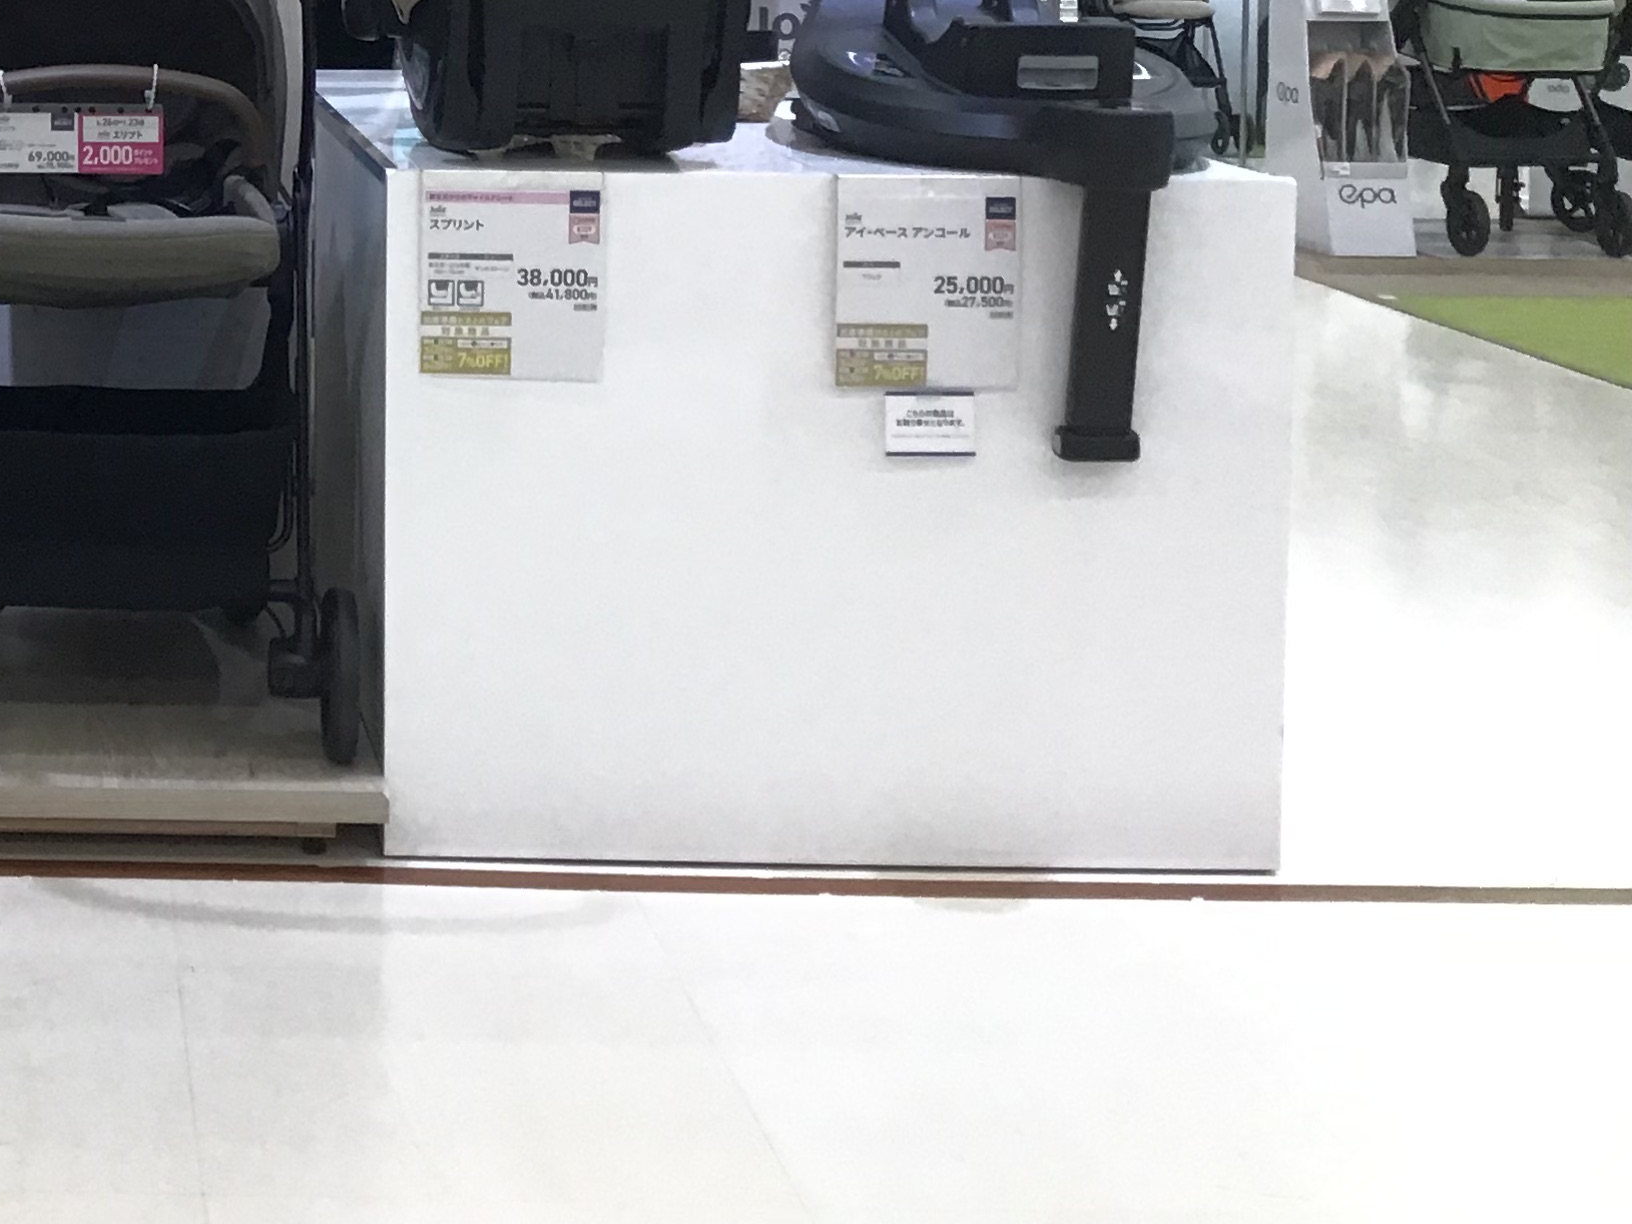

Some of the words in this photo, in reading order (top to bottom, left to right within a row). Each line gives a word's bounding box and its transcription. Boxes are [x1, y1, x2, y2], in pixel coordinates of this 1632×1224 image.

[82, 145, 133, 165] 2,000
[1338, 183, 1397, 209] epa
[430, 219, 484, 231] スプリント
[912, 227, 970, 239] アンコール
[517, 268, 598, 288] 38,000円
[933, 276, 1014, 295] 25,000円
